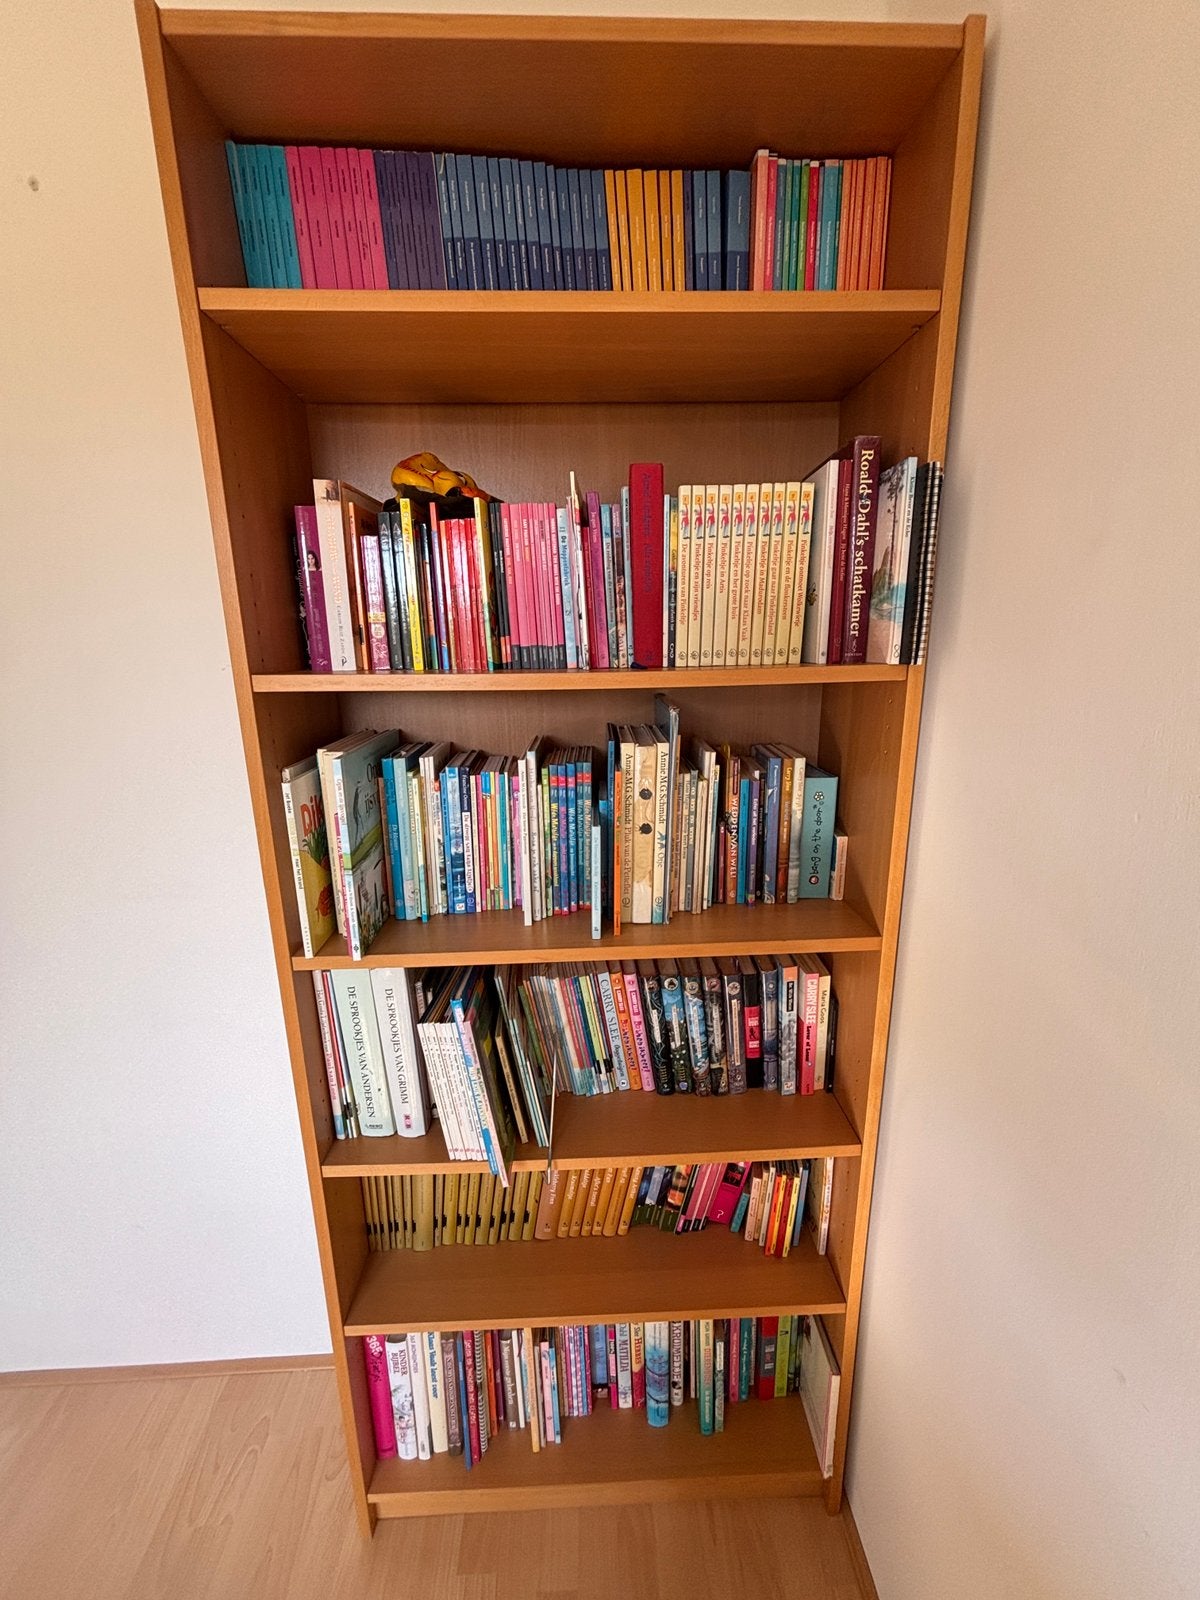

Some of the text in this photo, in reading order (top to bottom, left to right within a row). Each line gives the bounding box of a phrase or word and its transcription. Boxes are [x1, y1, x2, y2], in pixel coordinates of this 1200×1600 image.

[561, 535, 567, 543] De
[681, 544, 688, 552] De
[798, 539, 808, 566] Pinkeltje
[850, 449, 875, 637] Roald Dahl's schatkamer
[705, 542, 714, 569] Pinkeltje
[719, 542, 728, 569] Pinkeltje
[732, 541, 741, 568] Pinkeltje
[744, 541, 753, 569] Pinkeltje
[758, 540, 768, 567] Pinkeltje
[771, 540, 781, 566] Pinkeltje
[784, 540, 794, 566] Pinkeltje
[692, 543, 701, 621] Pinkeltje en zijn vriendjes
[705, 570, 711, 578] op
[733, 569, 738, 577] en
[743, 569, 750, 579] op
[770, 566, 779, 579] gaat
[785, 575, 792, 583] de
[798, 566, 806, 591] ontmoet
[730, 589, 739, 605] grote
[757, 577, 766, 615] Madurodam
[782, 583, 791, 620] flonkersteen
[679, 598, 687, 625] Pinkeltje
[766, 594, 777, 635] Pinkeltjesland
[625, 753, 634, 776] Annie
[660, 751, 668, 774] Annie
[624, 794, 633, 825] Schmidt
[658, 793, 667, 824] Schmidt
[730, 798, 738, 836] WEDDEN
[624, 827, 632, 844] Pluk
[729, 858, 737, 878] WEL!
[600, 979, 615, 1014] CARRY
[608, 1017, 620, 1042] SLEE
[806, 979, 817, 1024] CARRY SLEE
[820, 990, 828, 1007] Maria
[347, 986, 375, 1118] DE SPROOKJES VAN ANDERSEN
[385, 988, 409, 1104] DE SPROOKJES VAN GRIMM
[806, 1039, 811, 1047] of
[391, 1352, 400, 1374] BIJBEL
[399, 1349, 407, 1376] KINDER
[619, 1339, 628, 1372] MATILDA
[671, 1325, 681, 1380] KRUIMELTJE
